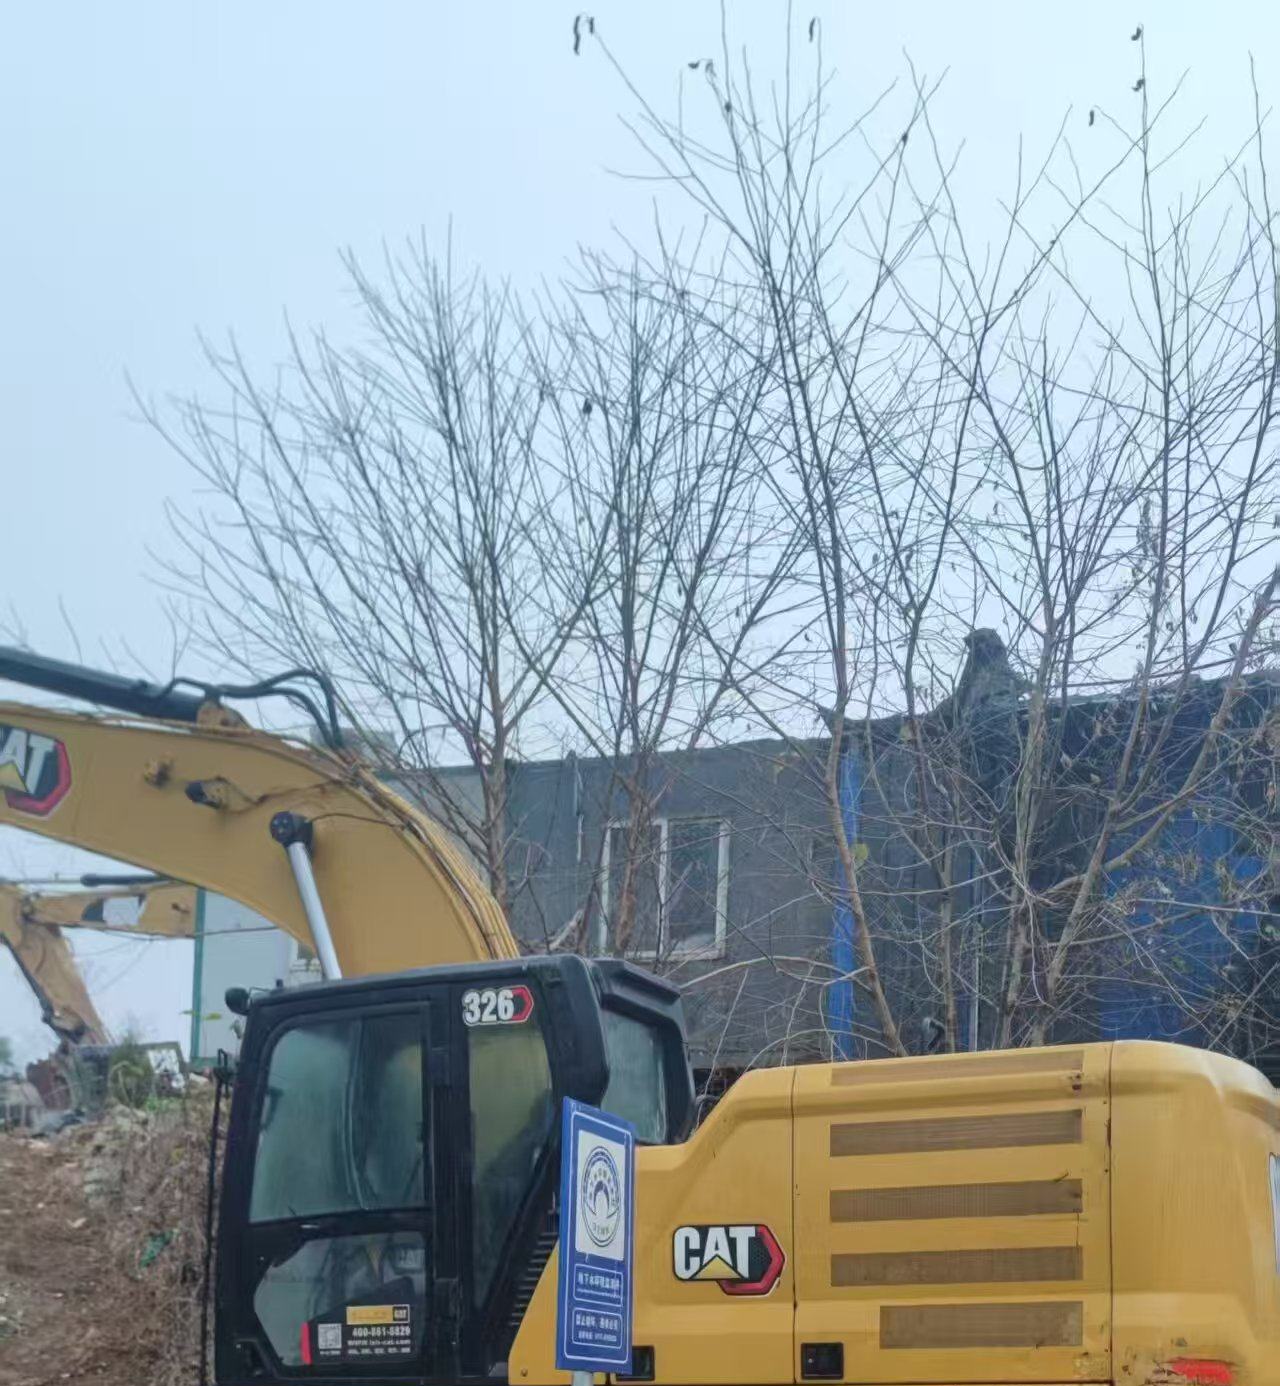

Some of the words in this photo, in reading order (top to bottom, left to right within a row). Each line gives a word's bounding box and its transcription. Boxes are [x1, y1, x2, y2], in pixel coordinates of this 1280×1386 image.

[0, 728, 55, 795] AT
[464, 989, 515, 1023] 326
[674, 1226, 756, 1280] CAT
